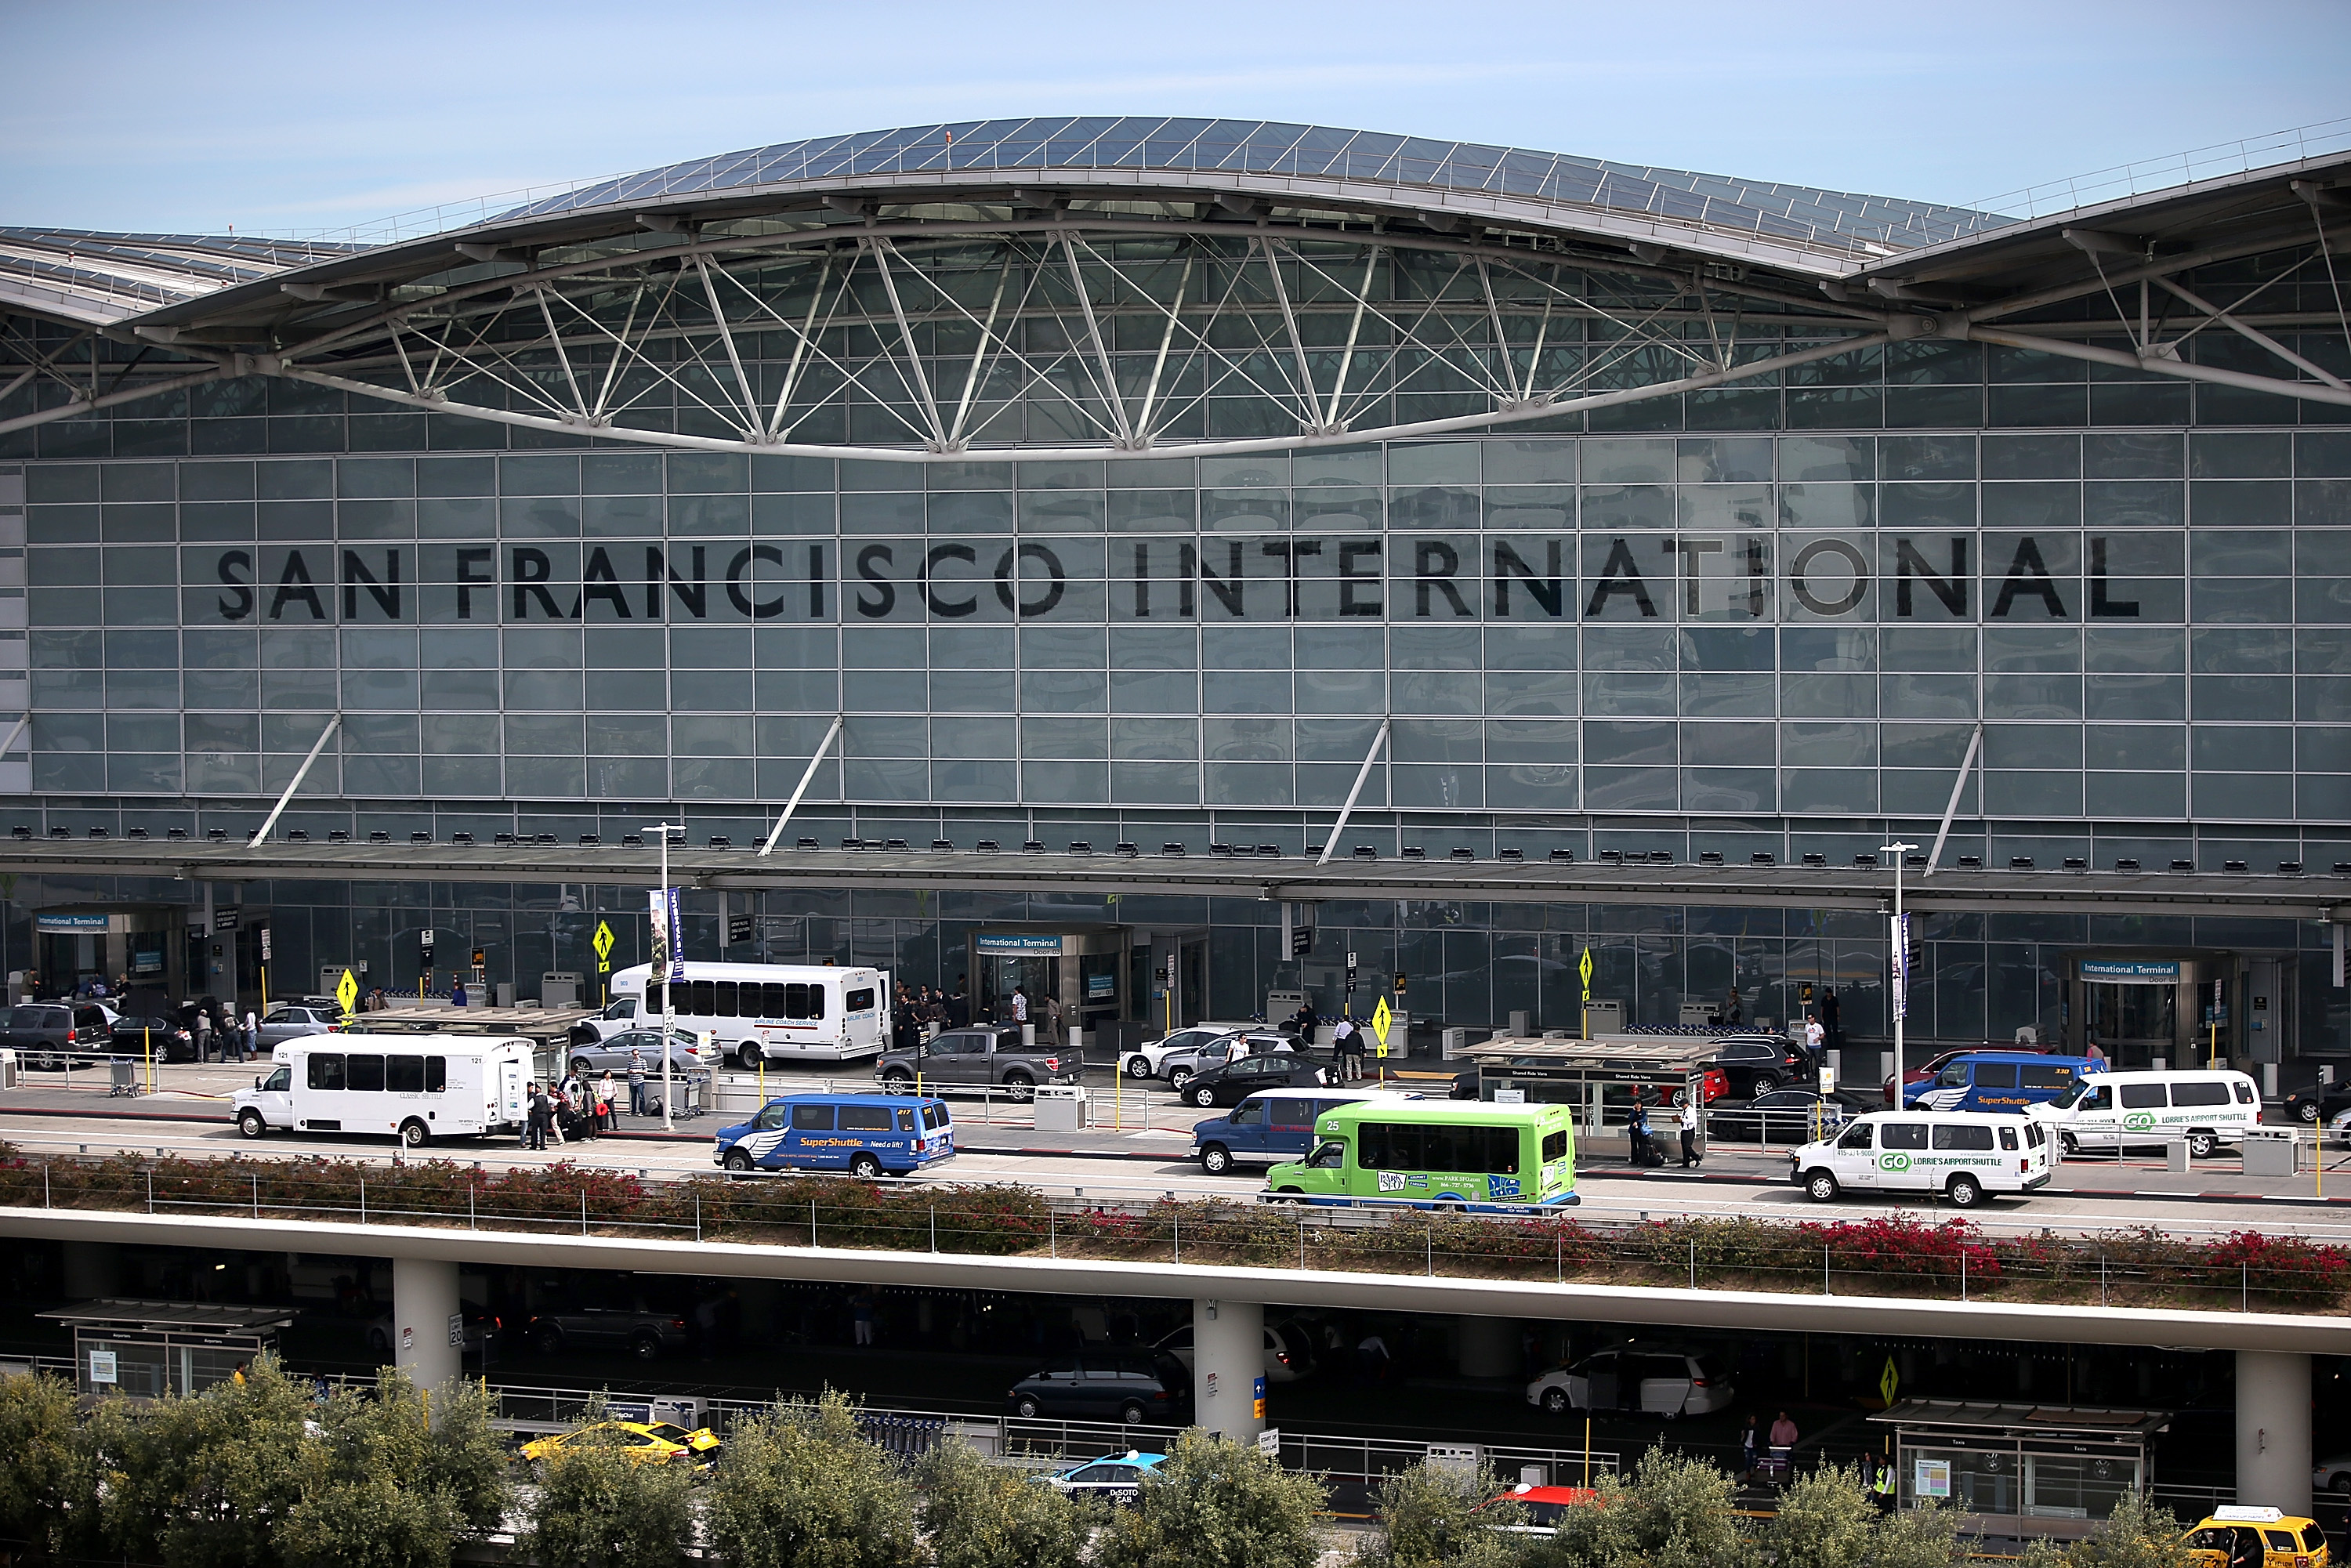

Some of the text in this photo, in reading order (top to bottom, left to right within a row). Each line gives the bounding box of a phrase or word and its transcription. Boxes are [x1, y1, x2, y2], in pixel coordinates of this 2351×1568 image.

[218, 537, 2139, 620] SAN FRANCISCO INTERNATIONAL
[38, 916, 71, 925] International
[980, 937, 1056, 947] International Terminal
[2085, 963, 2174, 974] International Terminal
[665, 1021, 675, 1033] 20
[1977, 1096, 2030, 1106] SuperShuttle
[1326, 1120, 1339, 1132] 25
[2125, 1114, 2153, 1128] GO
[2162, 1115, 2190, 1124] LORRIE'S
[799, 1138, 863, 1148] SuperShuttle
[1881, 1153, 2002, 1169] GO LORRIE'S AIRPORT SHUTTLE
[1380, 1173, 1403, 1185] PARK
[1382, 1179, 1401, 1190] SFO
[451, 1331, 462, 1343] 20
